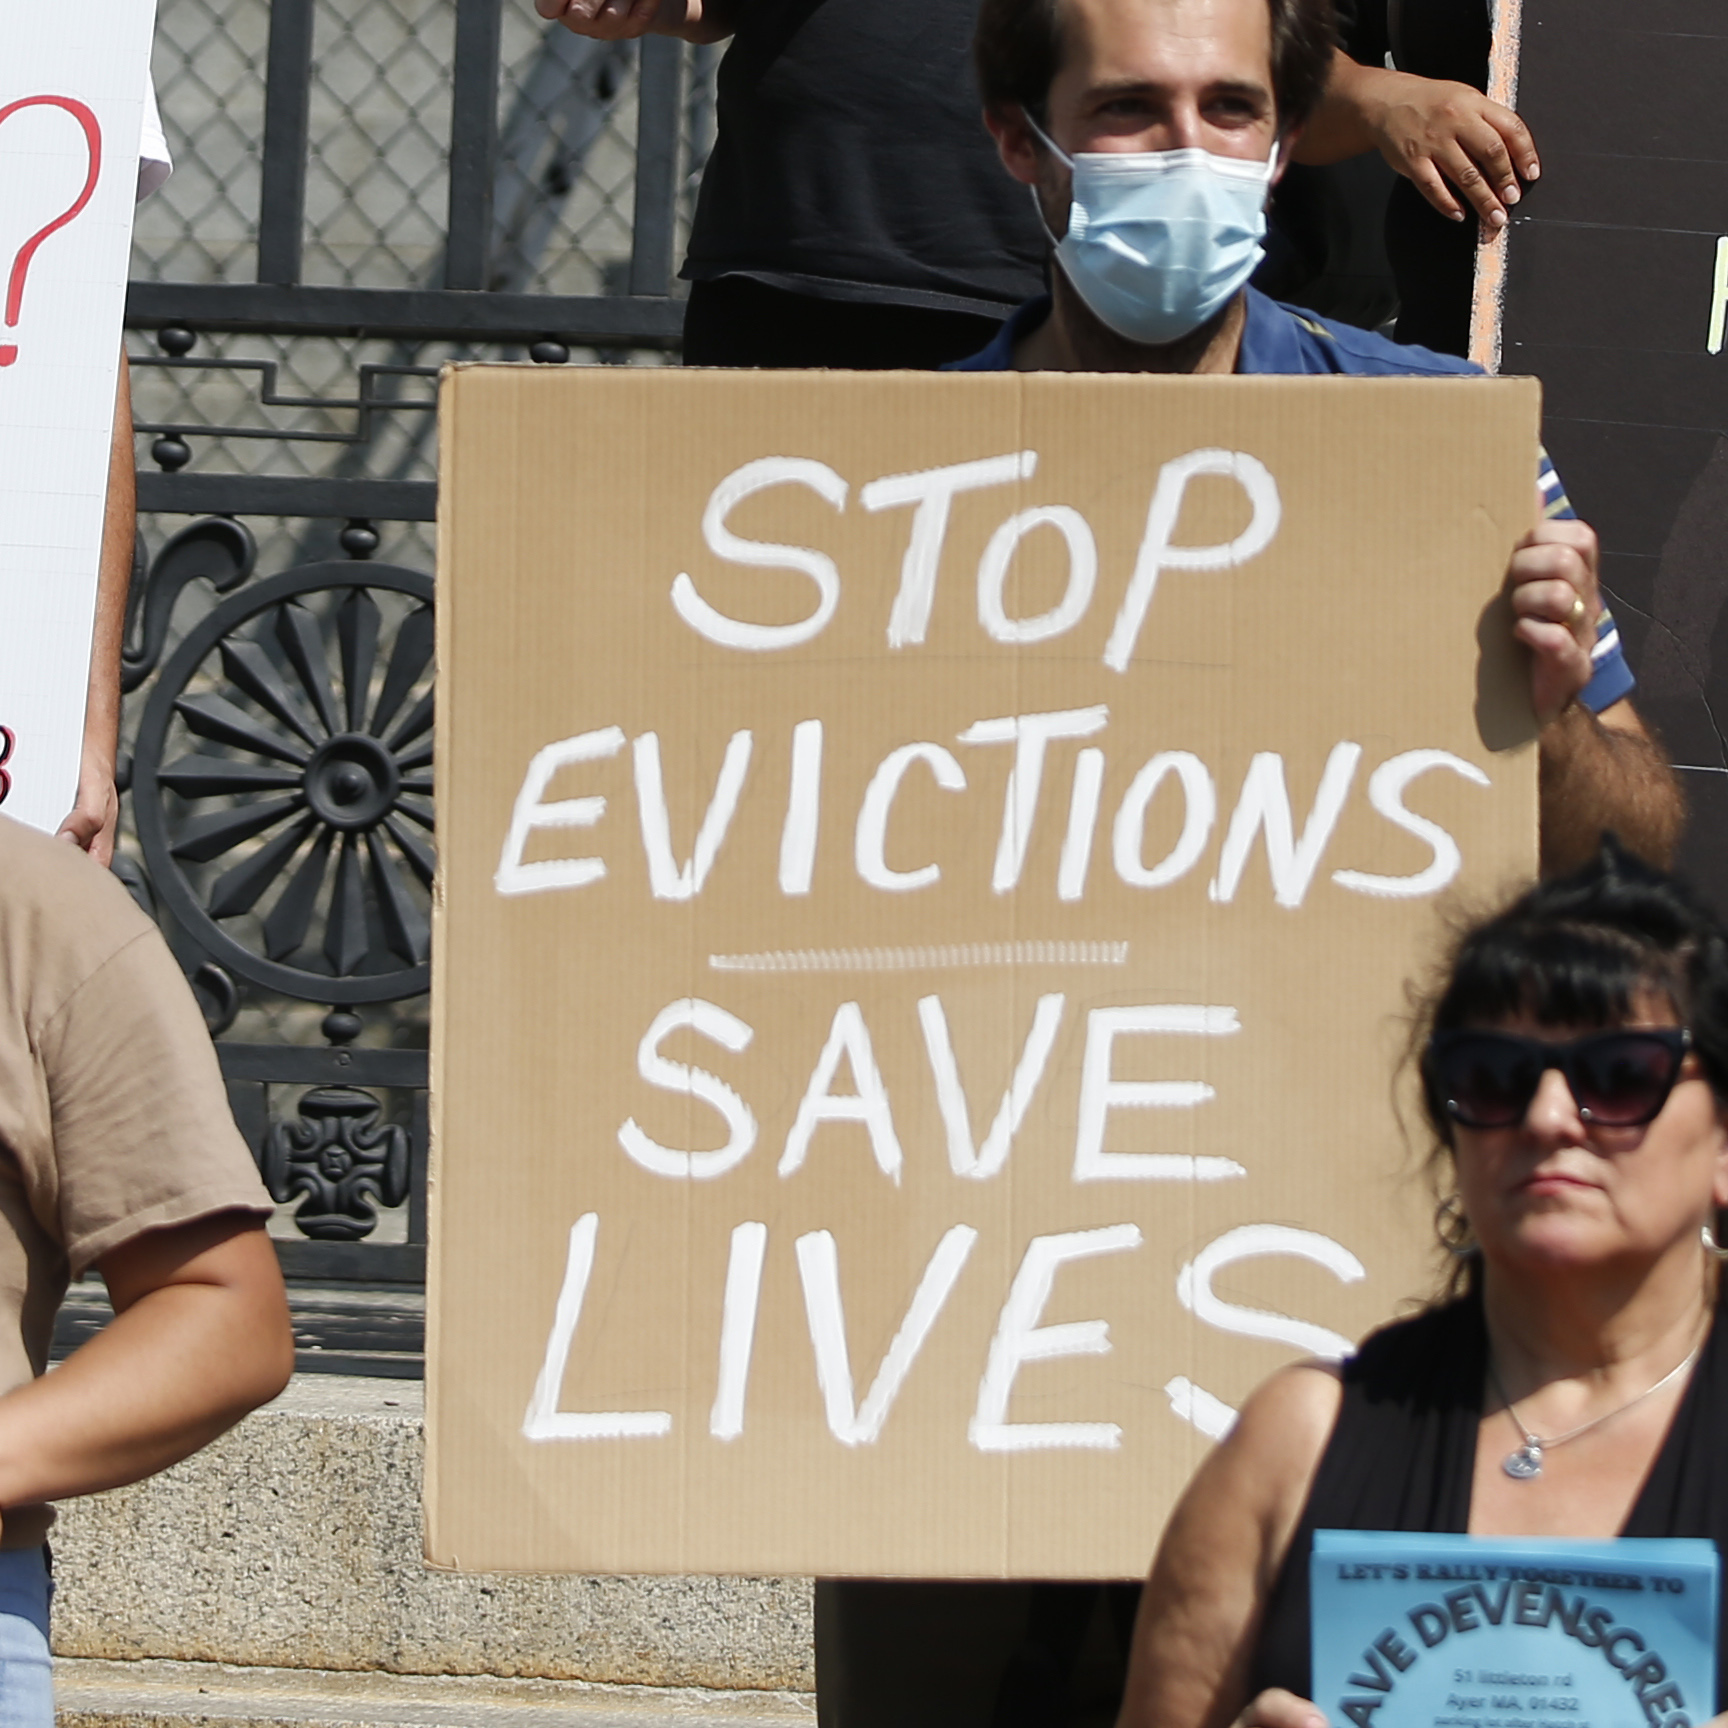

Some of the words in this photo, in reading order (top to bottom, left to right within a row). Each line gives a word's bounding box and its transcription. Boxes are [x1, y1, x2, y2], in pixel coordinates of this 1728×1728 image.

[671, 446, 1282, 672] STOP
[493, 704, 1491, 908] EVICTIONS
[616, 993, 1247, 1184] SAVE
[521, 1212, 1366, 1453] LIVES
[1337, 1562, 1410, 1581] LET'S
[1415, 1563, 1499, 1582] RALLY
[1649, 1575, 1685, 1594] TO
